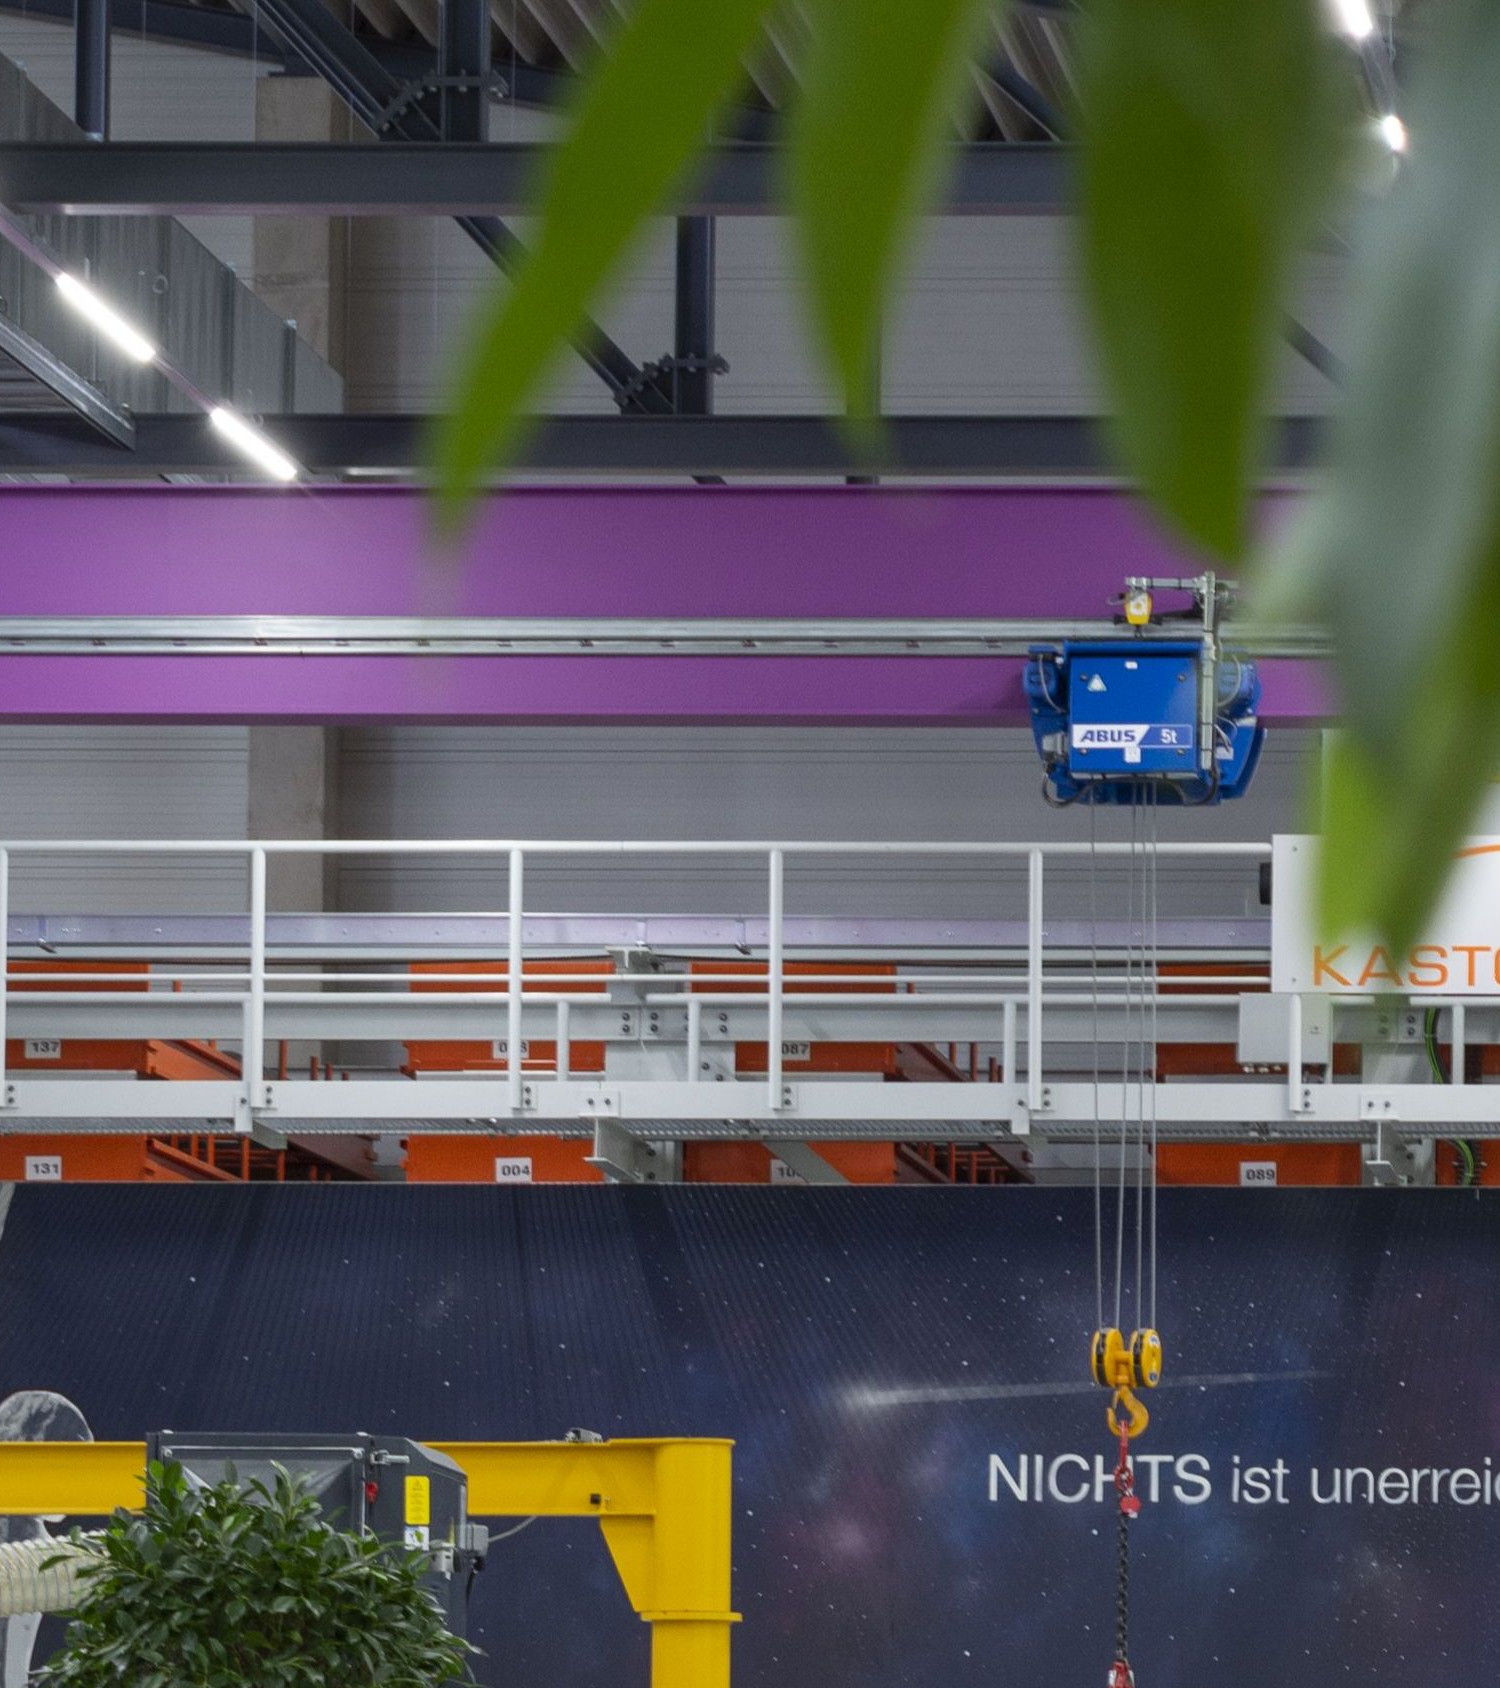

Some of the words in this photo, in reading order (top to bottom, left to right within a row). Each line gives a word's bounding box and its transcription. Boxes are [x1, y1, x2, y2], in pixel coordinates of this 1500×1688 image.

[1081, 729, 1136, 743] ABUS
[1160, 728, 1178, 744] 5t
[31, 1041, 59, 1053] 137
[32, 1162, 59, 1175] 131
[501, 1164, 529, 1177] 004
[1245, 1168, 1276, 1181] 089
[987, 1453, 1212, 1505] NICHTS
[1230, 1453, 1289, 1505] ist
